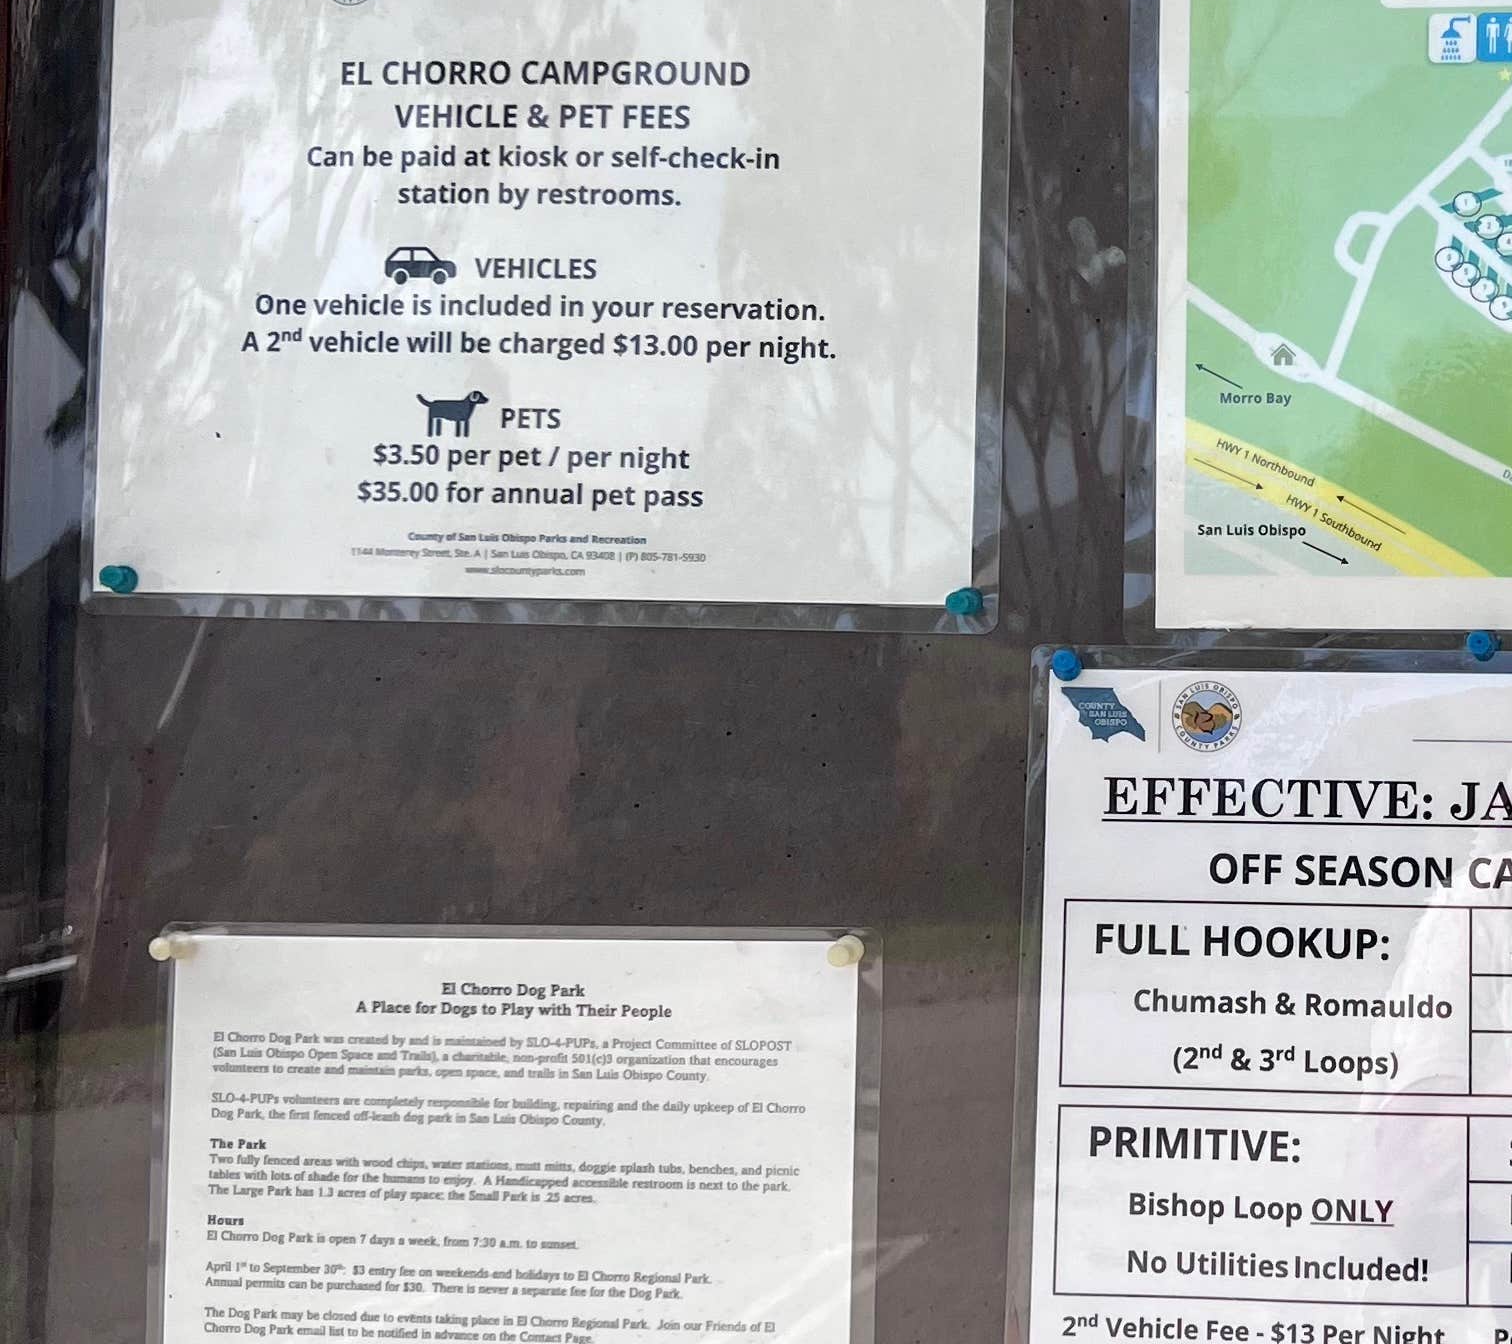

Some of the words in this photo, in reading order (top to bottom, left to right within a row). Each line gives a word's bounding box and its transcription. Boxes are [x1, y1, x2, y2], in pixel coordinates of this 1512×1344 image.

[341, 61, 373, 86] EL
[382, 60, 511, 86] CHORRO
[521, 60, 751, 87] CAMPGROUND
[475, 257, 597, 280] VEHICLES
[1219, 392, 1262, 404] Morro
[1266, 392, 1292, 408] Bay
[501, 407, 561, 430] PETS
[1216, 438, 1243, 456] HWY
[1244, 450, 1250, 460] 1
[1251, 453, 1316, 488] Northbound
[357, 480, 439, 503] $35.00
[445, 481, 484, 503] for
[491, 482, 583, 505] annual
[591, 486, 636, 512] pet
[644, 489, 704, 513] pass
[1103, 776, 1433, 820] EFFECTIVE:
[1095, 923, 1190, 956] FULL
[1204, 925, 1389, 961] HOOKUP:
[441, 982, 457, 995] El
[460, 982, 513, 997] Chorro
[516, 983, 547, 1001] Dog
[550, 983, 585, 997] Park
[209, 1137, 234, 1150] The
[237, 1138, 267, 1150] Park
[1089, 1125, 1301, 1164] PRIMITIVE:
[207, 1214, 245, 1226] Hours
[1127, 1250, 1167, 1274] No
[1176, 1251, 1289, 1278] Utilities
[1294, 1255, 1429, 1282] Included!
